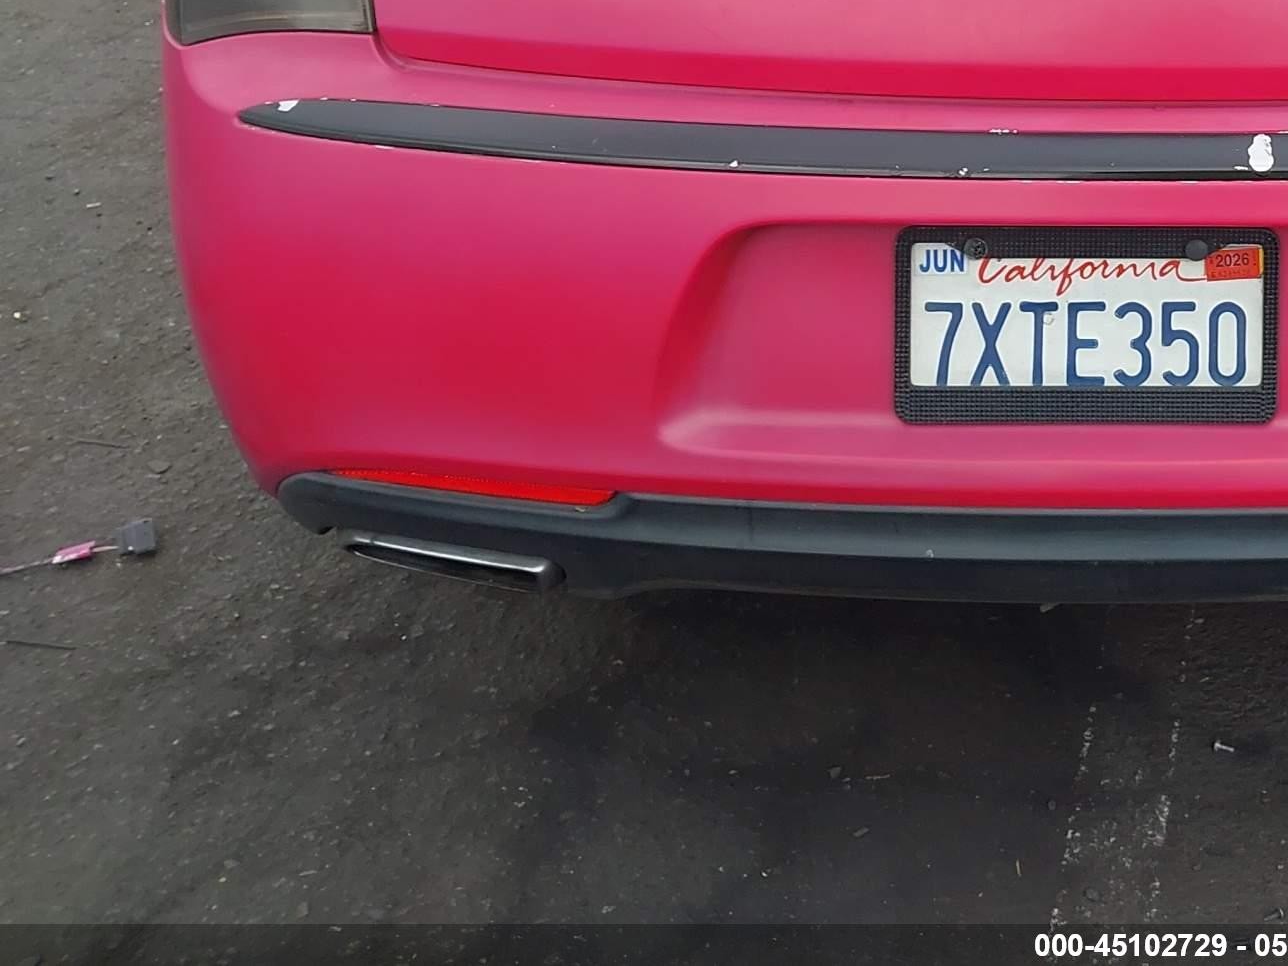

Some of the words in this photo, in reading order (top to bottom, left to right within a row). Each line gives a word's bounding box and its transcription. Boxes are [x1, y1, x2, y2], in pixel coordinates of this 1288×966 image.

[919, 249, 965, 273] JUN
[978, 256, 1206, 296] California
[1215, 252, 1250, 268] 2026
[924, 301, 1247, 386] 7XTE350
